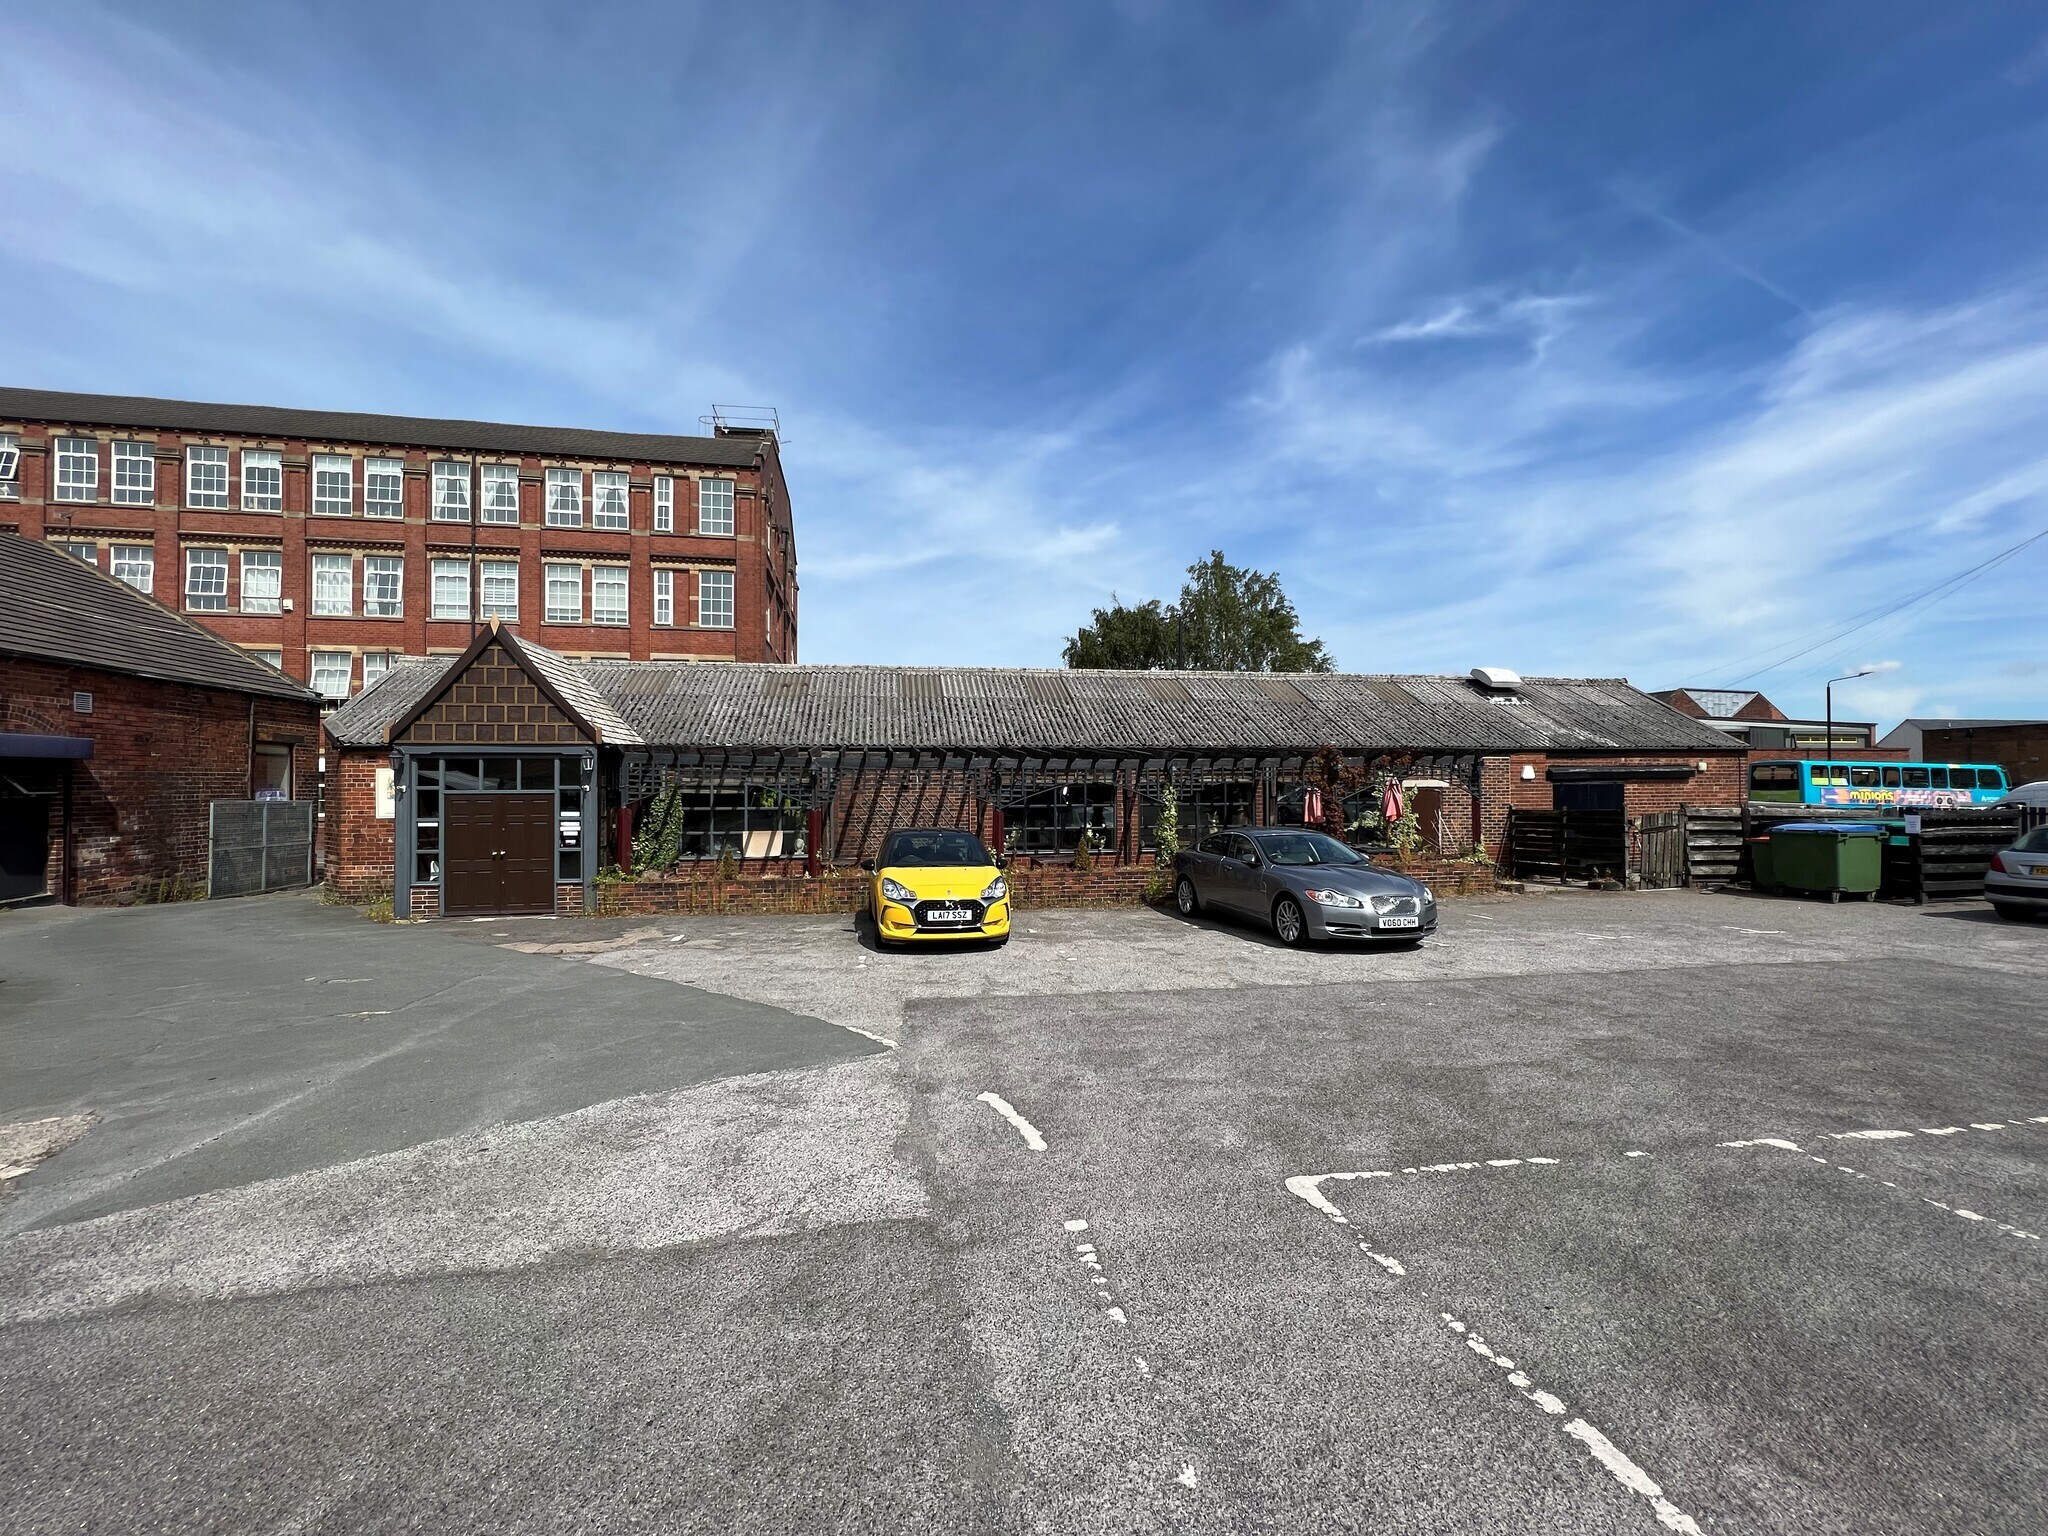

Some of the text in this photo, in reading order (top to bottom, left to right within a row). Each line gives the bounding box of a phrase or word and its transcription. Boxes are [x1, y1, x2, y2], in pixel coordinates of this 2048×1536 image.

[932, 911, 967, 919] LA17 SSZ
[1403, 918, 1416, 926] CHH
